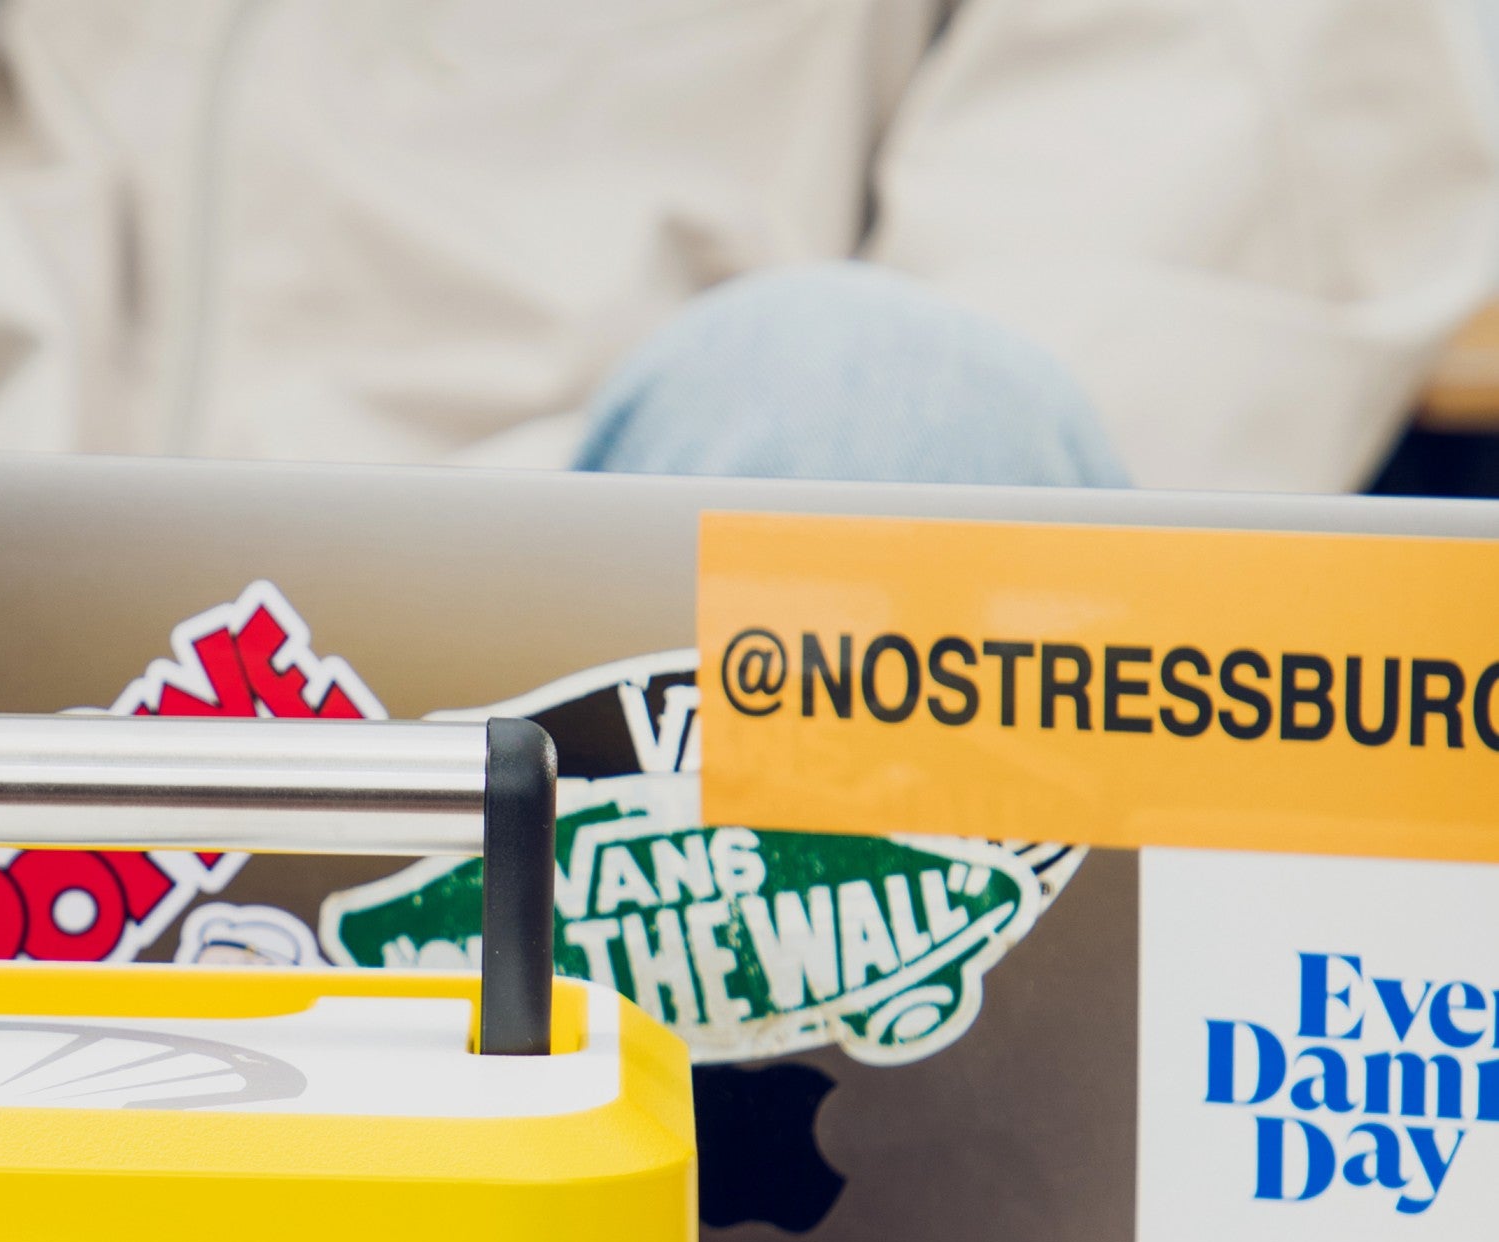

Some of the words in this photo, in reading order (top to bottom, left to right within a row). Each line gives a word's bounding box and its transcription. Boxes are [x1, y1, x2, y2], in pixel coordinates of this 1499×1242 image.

[565, 900, 752, 1025] THE
[1295, 951, 1499, 1049] Eve
[1252, 1115, 1465, 1215] Day
